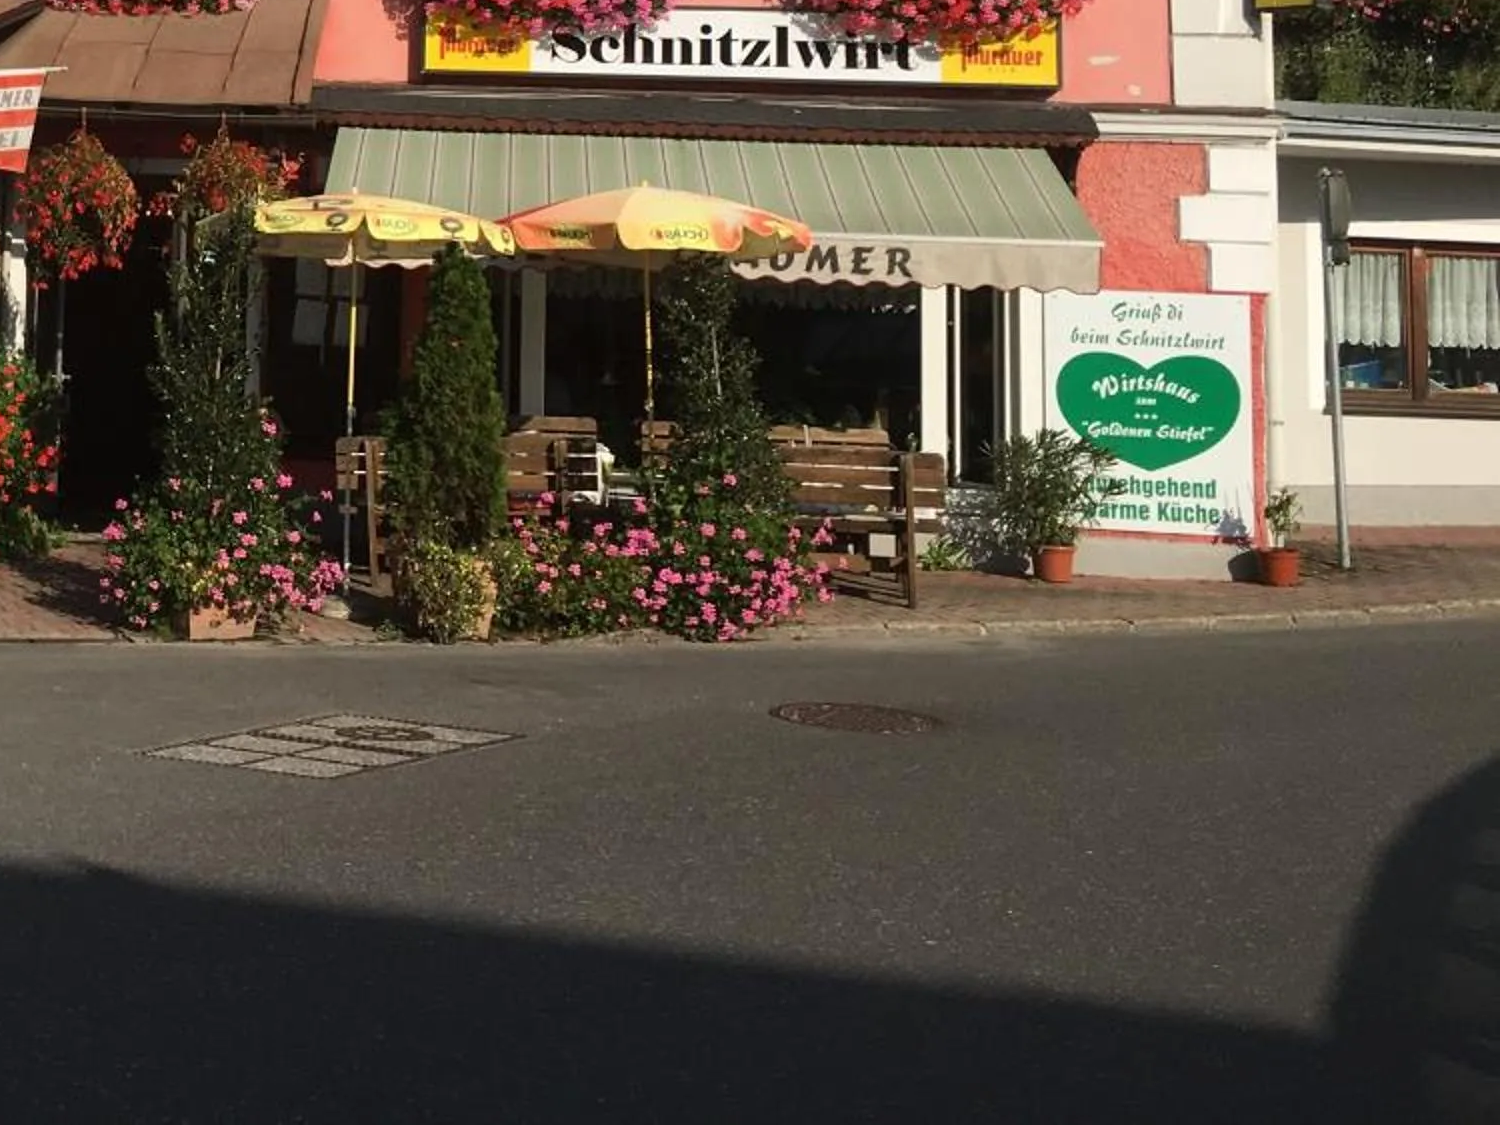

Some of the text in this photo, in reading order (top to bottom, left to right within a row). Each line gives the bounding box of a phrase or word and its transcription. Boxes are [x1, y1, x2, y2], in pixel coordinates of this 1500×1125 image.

[550, 18, 917, 71] Schnitzlwirt
[1070, 326, 1226, 351] beim Schnitzlwirt
[1090, 373, 1201, 405] Wirtshaus
[1135, 396, 1157, 407] zum
[1156, 500, 1221, 525] Küche
